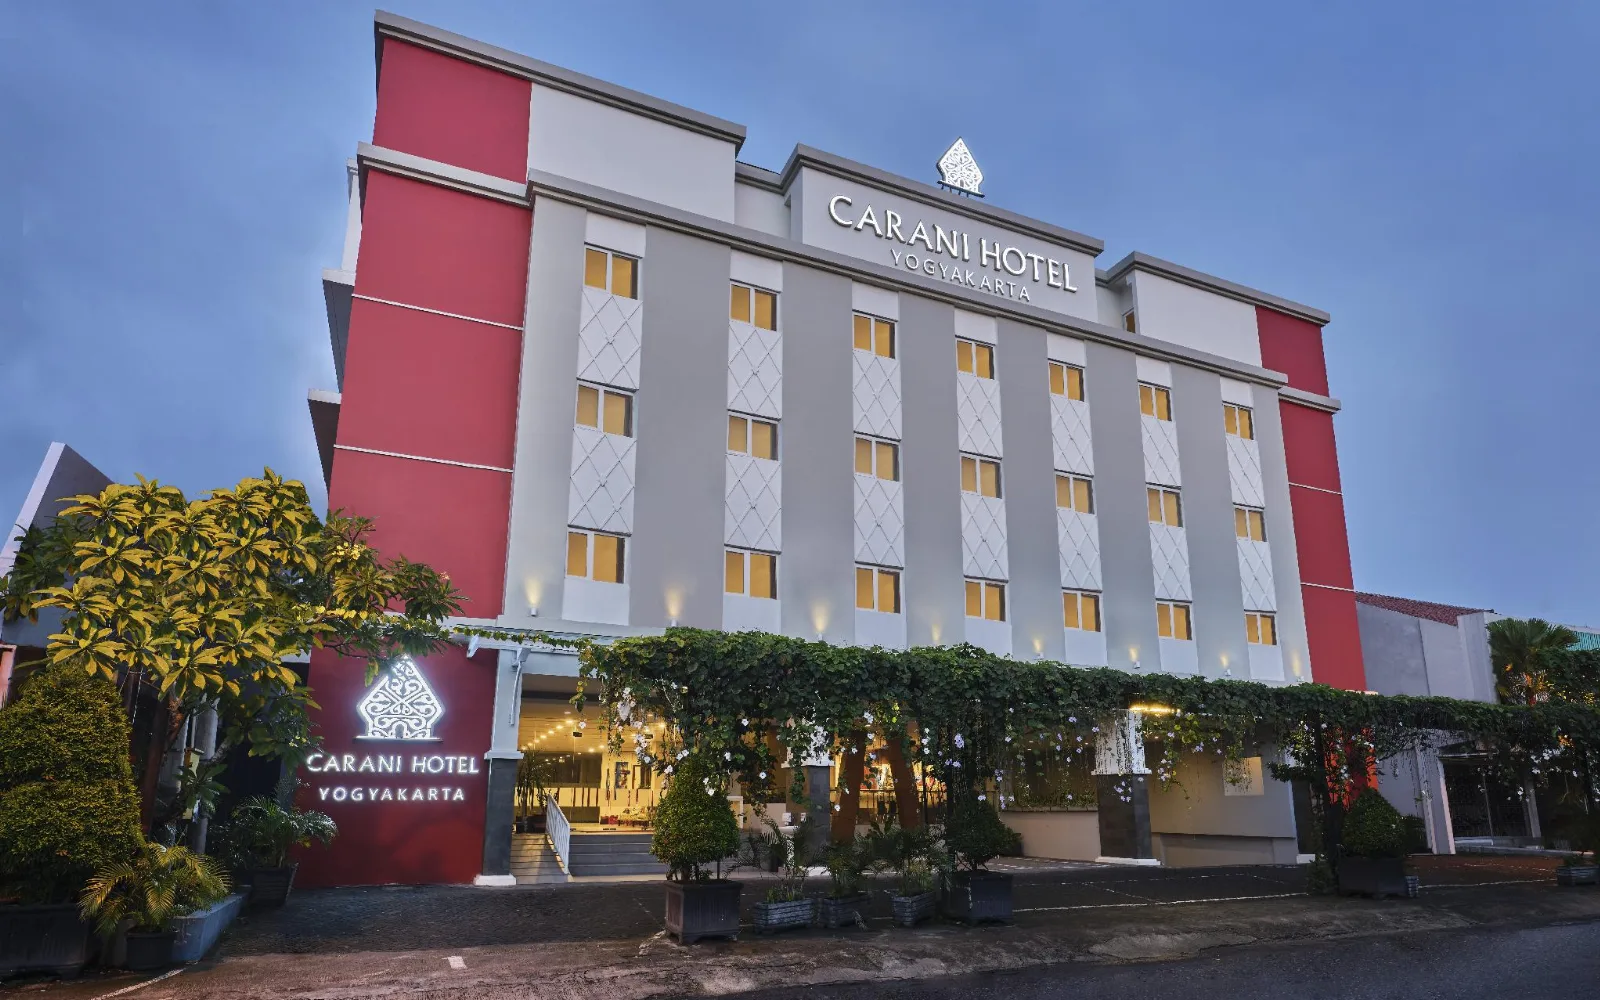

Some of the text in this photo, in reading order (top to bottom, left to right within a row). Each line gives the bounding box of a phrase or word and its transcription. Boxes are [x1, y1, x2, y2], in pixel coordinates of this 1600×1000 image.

[828, 195, 1079, 293] CARANI HOTEL
[891, 248, 1030, 302] YOGYAKARTA
[306, 753, 480, 773] CARANI HOTEL
[318, 786, 465, 802] YOGYAKARTA
